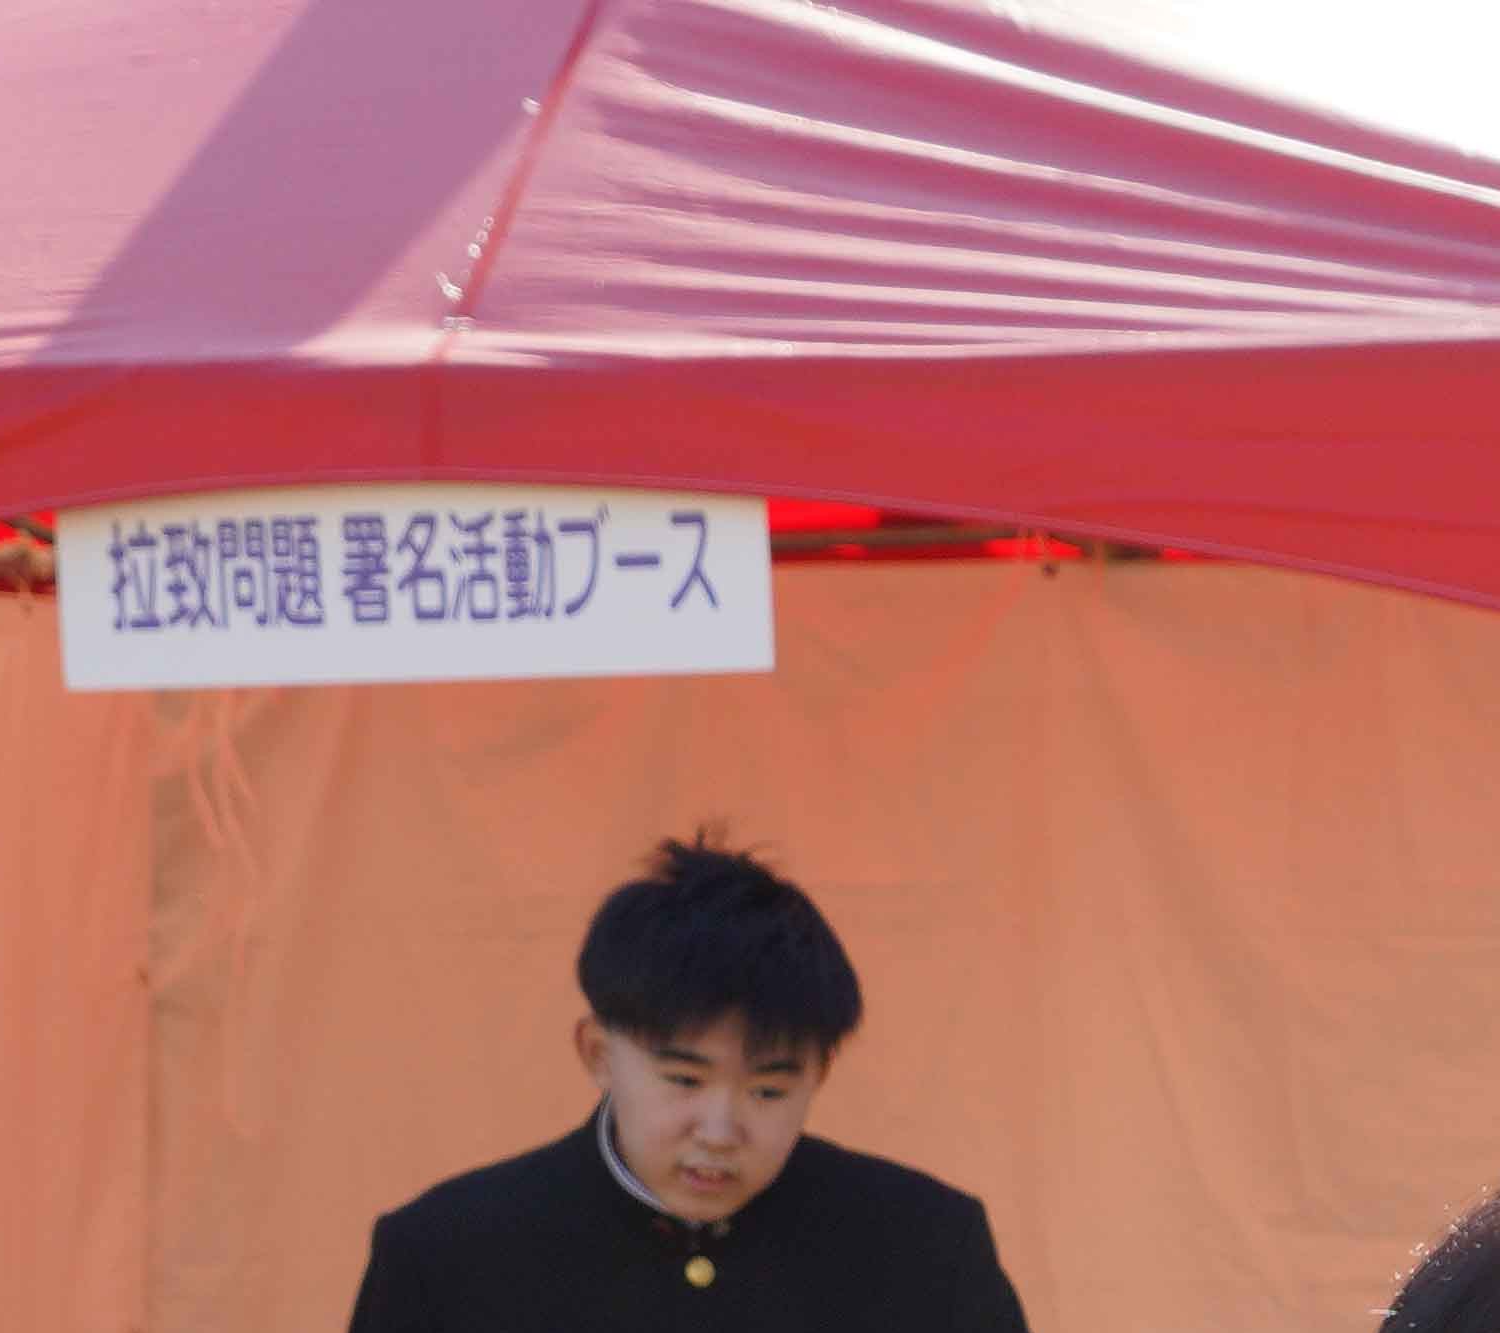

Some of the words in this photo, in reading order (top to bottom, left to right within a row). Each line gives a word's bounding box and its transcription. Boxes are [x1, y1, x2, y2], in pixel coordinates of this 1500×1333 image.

[109, 512, 325, 631] 拉致問題
[341, 503, 720, 626] 署名活動ブース
